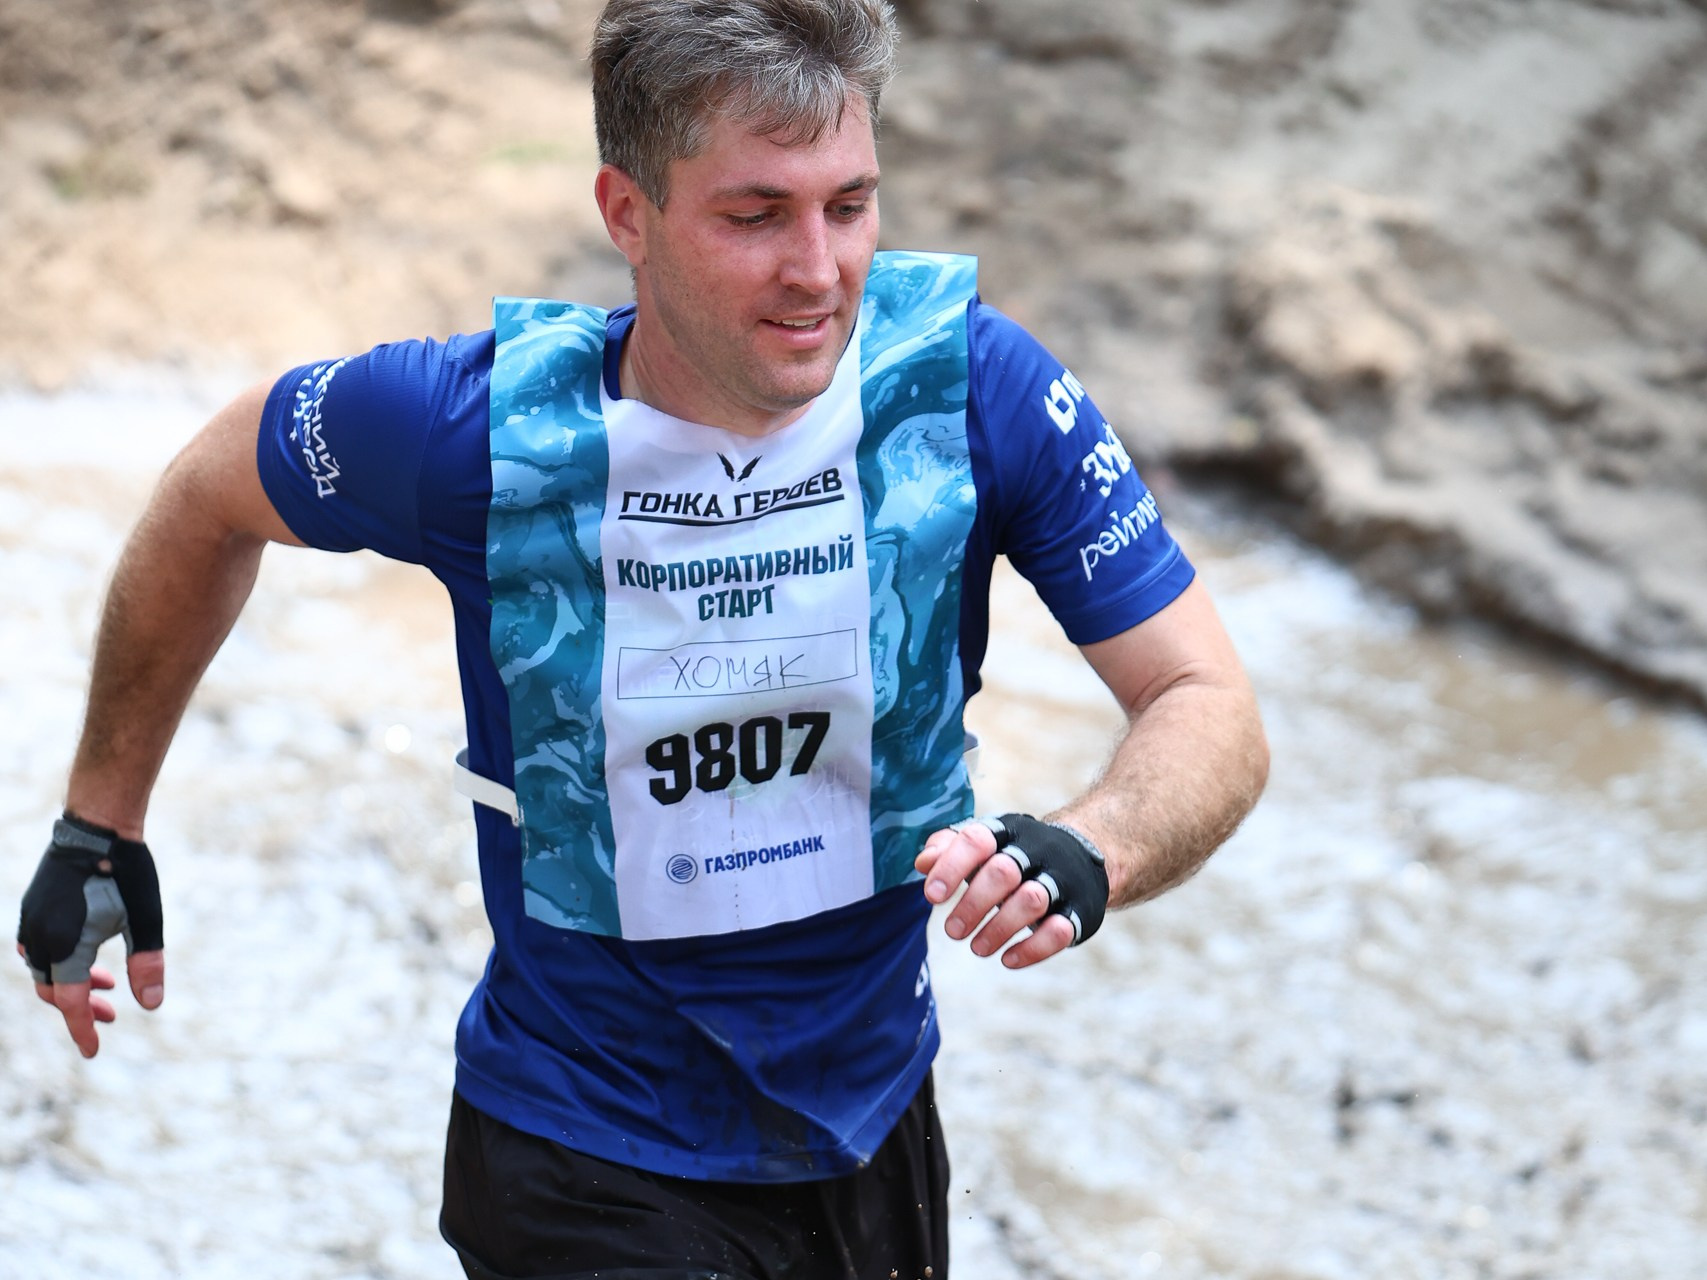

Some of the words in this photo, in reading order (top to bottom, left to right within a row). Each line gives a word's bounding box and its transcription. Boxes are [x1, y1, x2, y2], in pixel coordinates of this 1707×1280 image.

[620, 490, 724, 518] ГОНКА
[733, 467, 843, 516] ГЕРОЕВ
[617, 534, 854, 592] КОРПОРАТИВНЫЙ
[698, 584, 775, 621] СТАРТ
[670, 654, 808, 690] ХОМЯК
[645, 712, 831, 806] 9807
[704, 835, 825, 874] ГАЗПРОМБАНК
